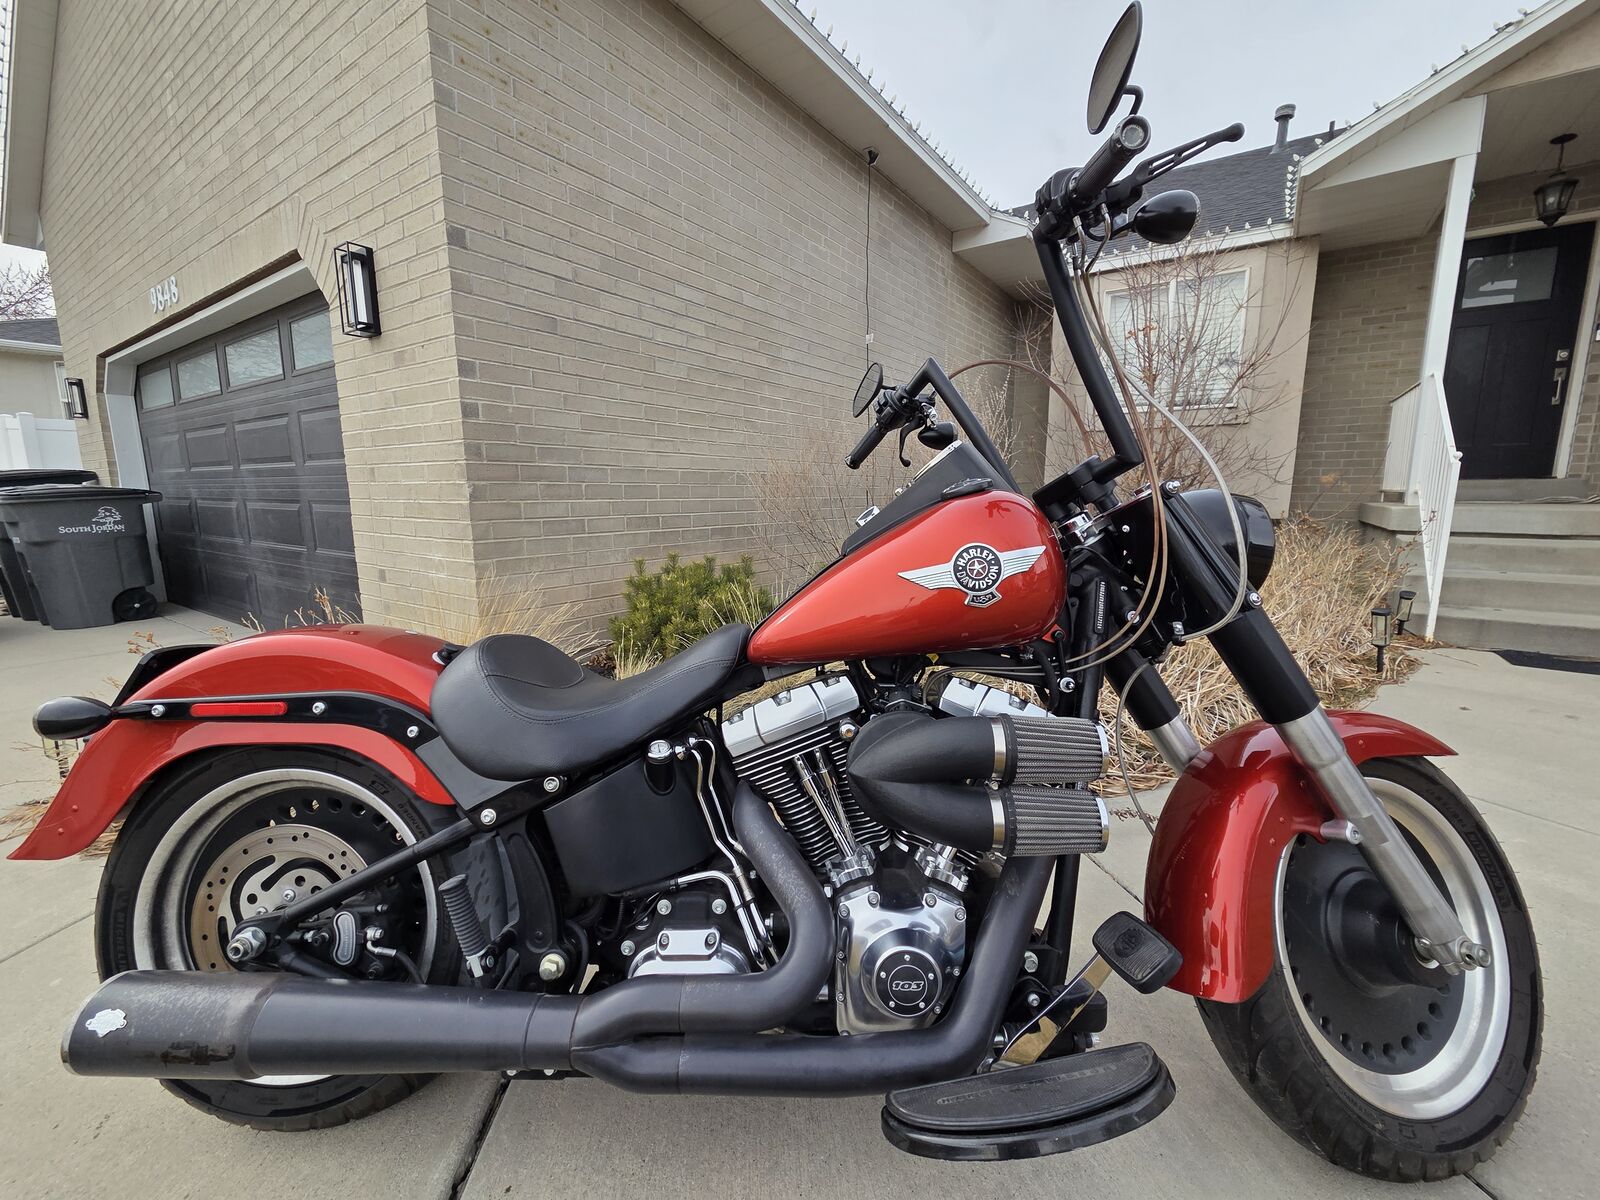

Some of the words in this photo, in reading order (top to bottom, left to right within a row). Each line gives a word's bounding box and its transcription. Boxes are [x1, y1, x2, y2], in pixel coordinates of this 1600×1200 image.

[150, 275, 179, 313] 9848
[58, 525, 91, 534] SOUTH
[91, 524, 125, 533] JORDAN
[956, 548, 995, 566] HARLEY
[956, 565, 999, 589] DAVIDSON
[892, 981, 924, 991] 103
